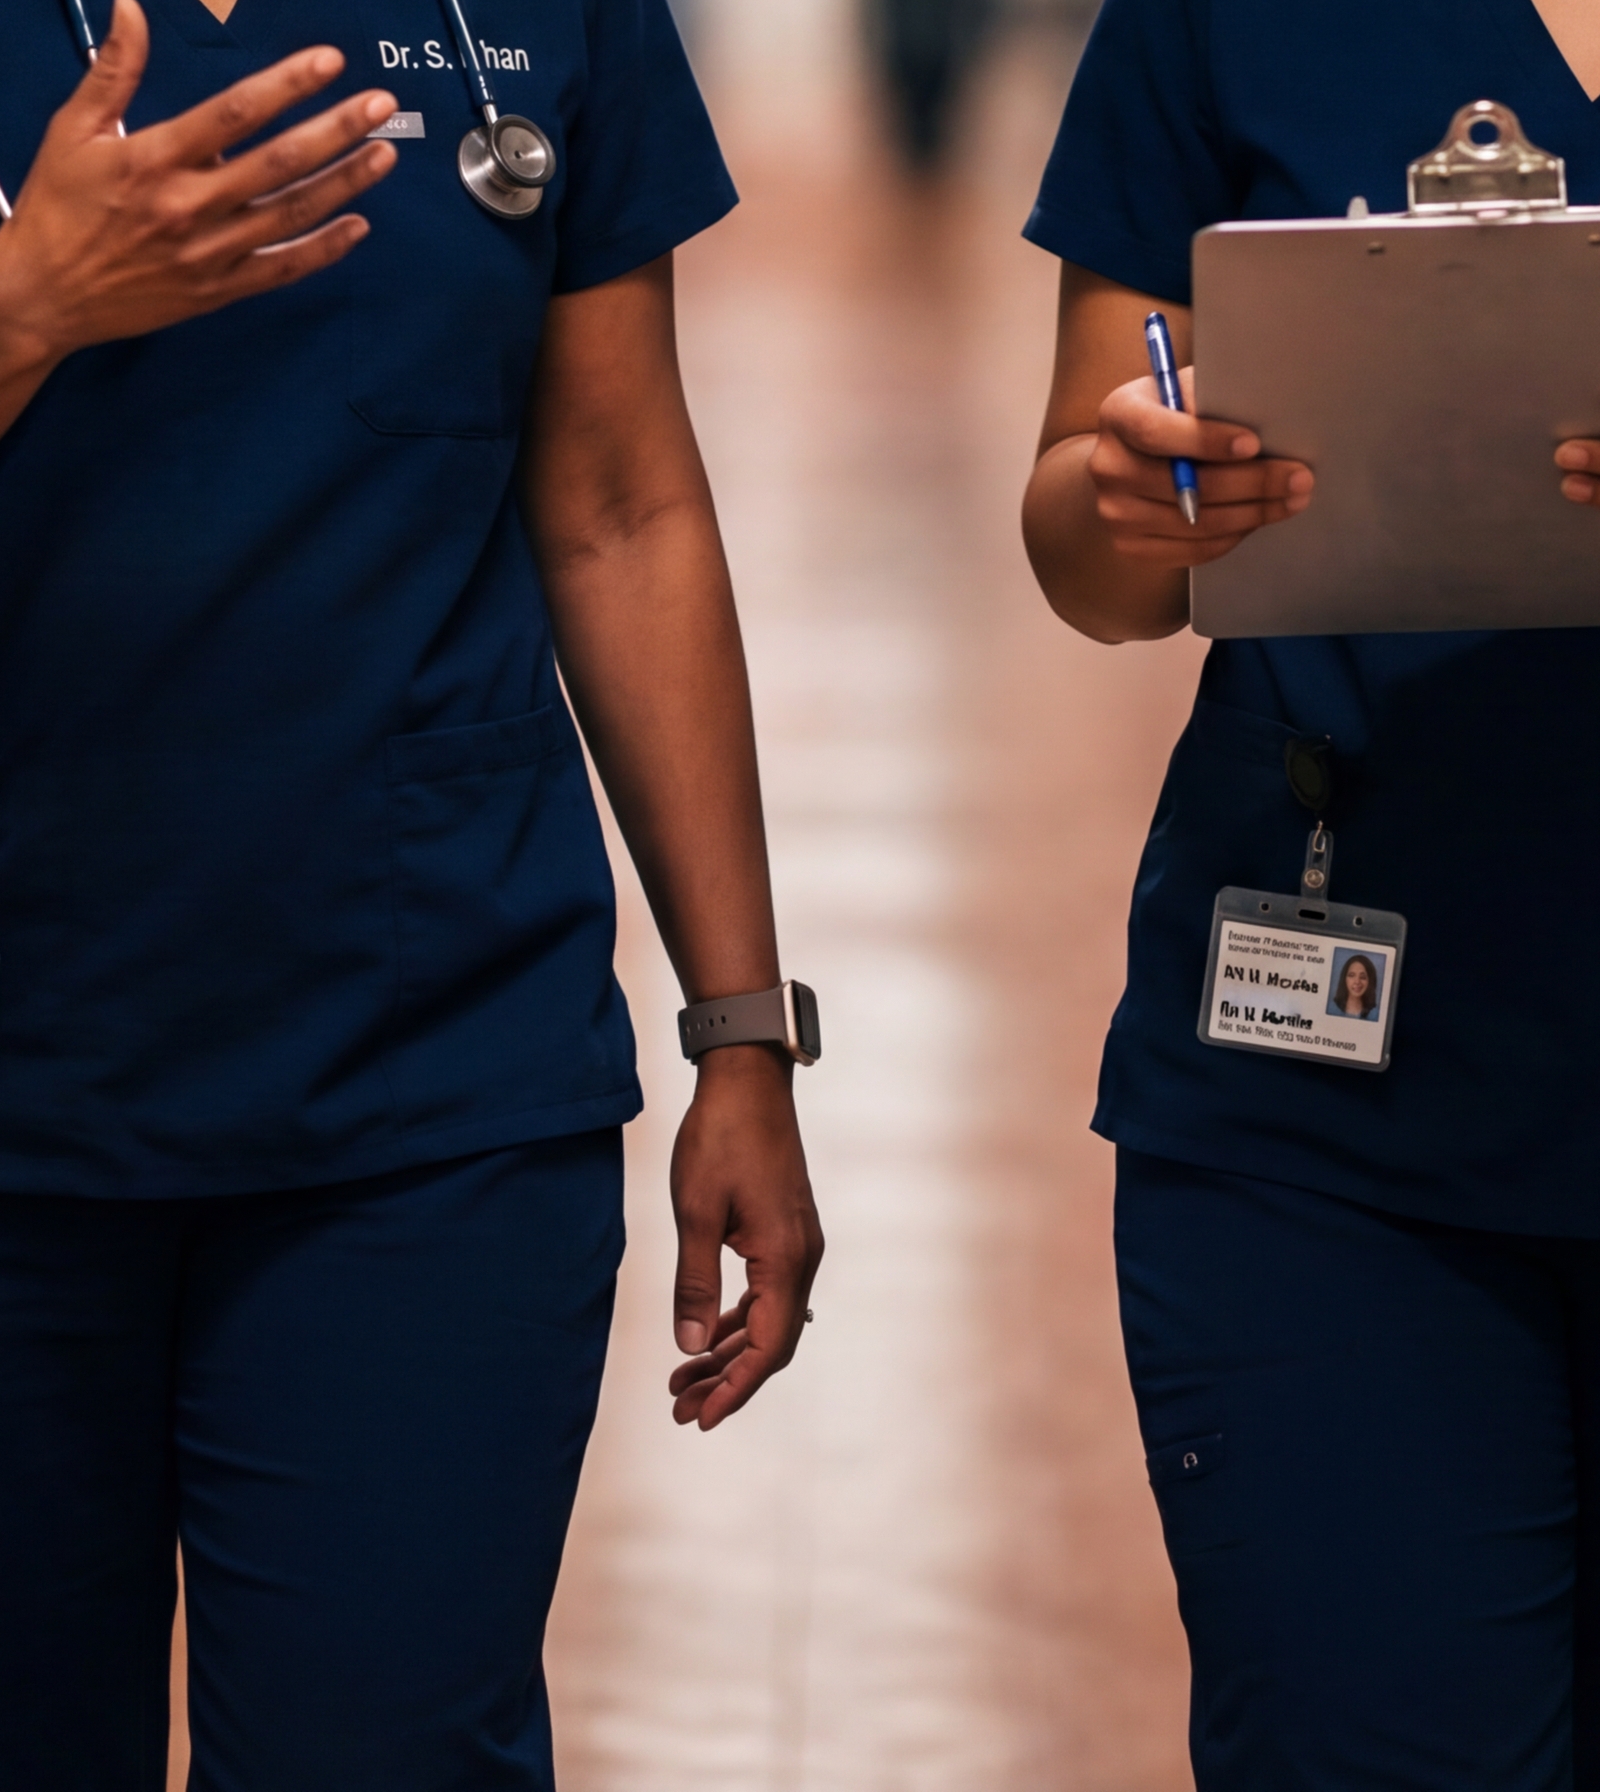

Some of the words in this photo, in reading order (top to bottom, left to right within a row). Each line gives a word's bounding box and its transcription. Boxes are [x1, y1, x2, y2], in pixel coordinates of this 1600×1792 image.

[378, 40, 419, 69] Dr.
[424, 40, 453, 70] S.
[460, 39, 530, 71] han
